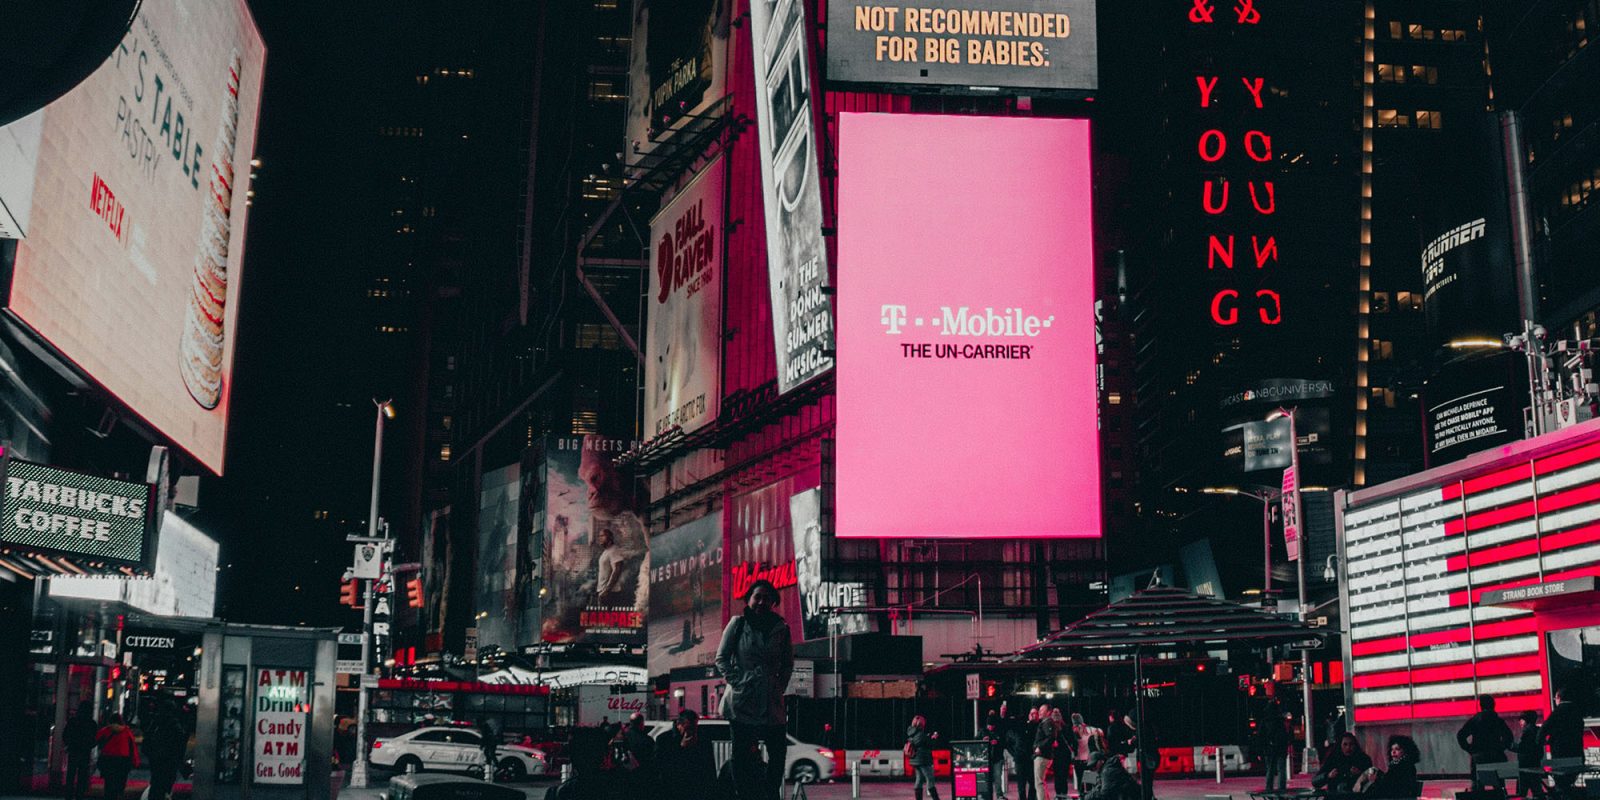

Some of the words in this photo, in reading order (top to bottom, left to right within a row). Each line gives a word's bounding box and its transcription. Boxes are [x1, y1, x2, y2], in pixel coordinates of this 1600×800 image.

[855, 6, 898, 32] NOT
[905, 8, 1070, 38] RECOMMENDED
[876, 36, 917, 62] FOR
[925, 38, 960, 64] BIG
[967, 39, 1050, 67] BABIES.
[115, 95, 160, 186] PASTRY
[153, 73, 203, 191] TABLE
[90, 171, 125, 242] NETFLIX
[1196, 76, 1239, 325] YOUNG
[1428, 217, 1486, 263] RUNNER
[800, 256, 819, 288] THE
[790, 284, 828, 322] DONNA
[787, 310, 830, 353] SUMMER
[901, 344, 931, 358] THE
[785, 340, 835, 383] MUSICAL
[1256, 382, 1336, 400] NBCUNIVERSAL
[1482, 406, 1495, 416] APP
[558, 438, 578, 450] BIG
[586, 439, 623, 451] MEETS
[8, 476, 144, 519] TARBUCKS
[15, 508, 112, 541] COFFEE
[650, 547, 723, 584] WESTWORLD
[1502, 588, 1526, 601] STRAND
[1527, 586, 1544, 597] BOOK
[1544, 582, 1565, 594] STORE
[580, 611, 643, 628] RAMPAGE
[125, 635, 175, 649] CITIZEN
[259, 670, 305, 687] ATM
[595, 671, 641, 684] LOFT
[270, 687, 299, 698] ATM
[259, 696, 309, 712] Drink
[258, 718, 302, 738] Candy
[263, 741, 299, 756] ATM
[456, 751, 481, 762] NYP
[257, 762, 276, 778] Gen.
